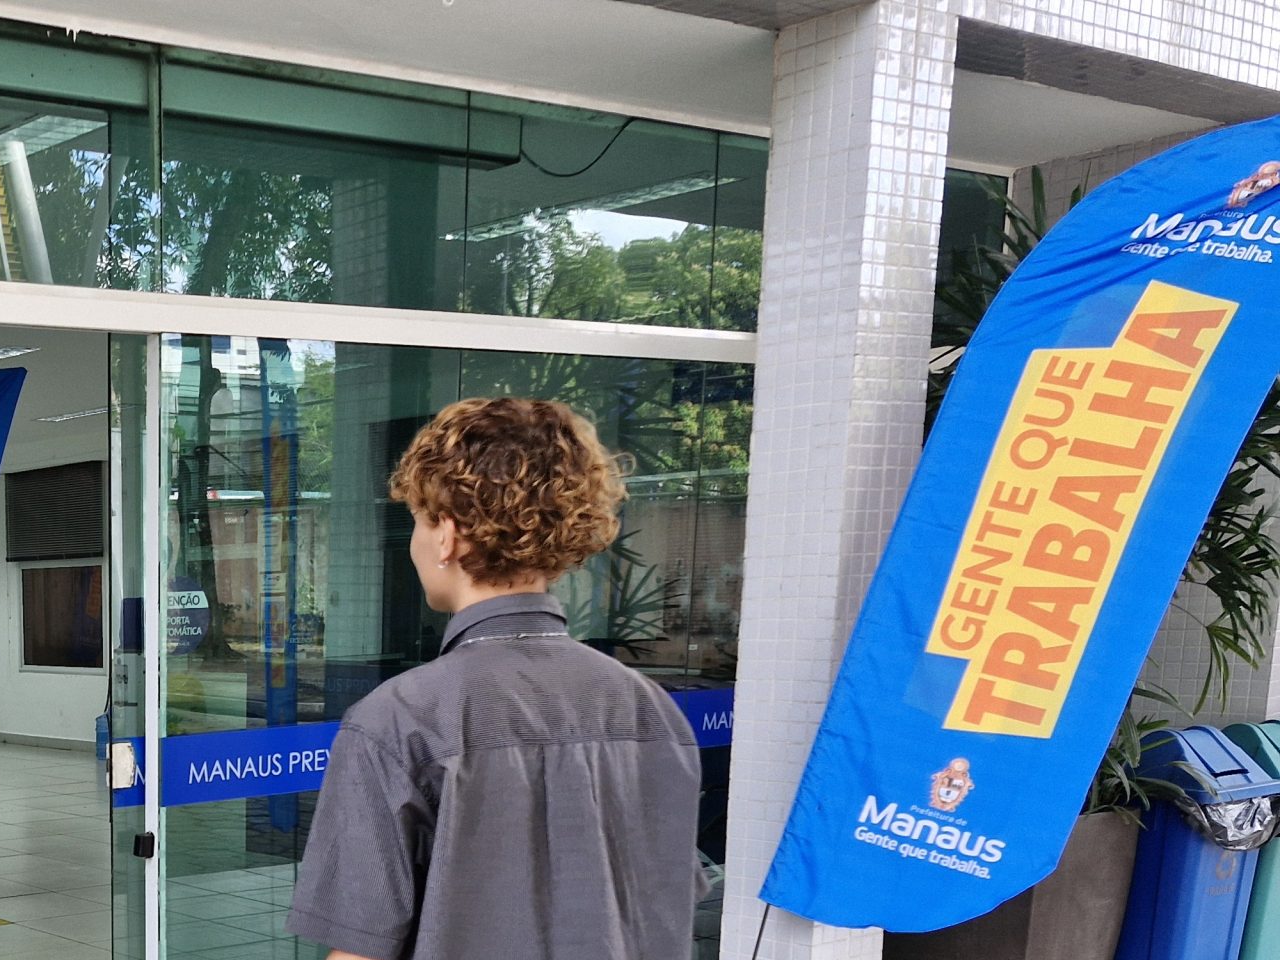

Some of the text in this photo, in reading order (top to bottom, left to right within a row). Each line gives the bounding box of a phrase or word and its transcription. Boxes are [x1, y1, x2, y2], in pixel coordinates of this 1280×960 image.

[1202, 240, 1273, 263] trabalha.
[939, 355, 1096, 651] GENTE QUE
[962, 308, 1229, 727] TRABALHA
[189, 753, 282, 785] MANAUS
[858, 794, 1007, 863] Manaus
[910, 804, 968, 827] Prefeitura de
[854, 826, 992, 880] Gente que trabalha.
